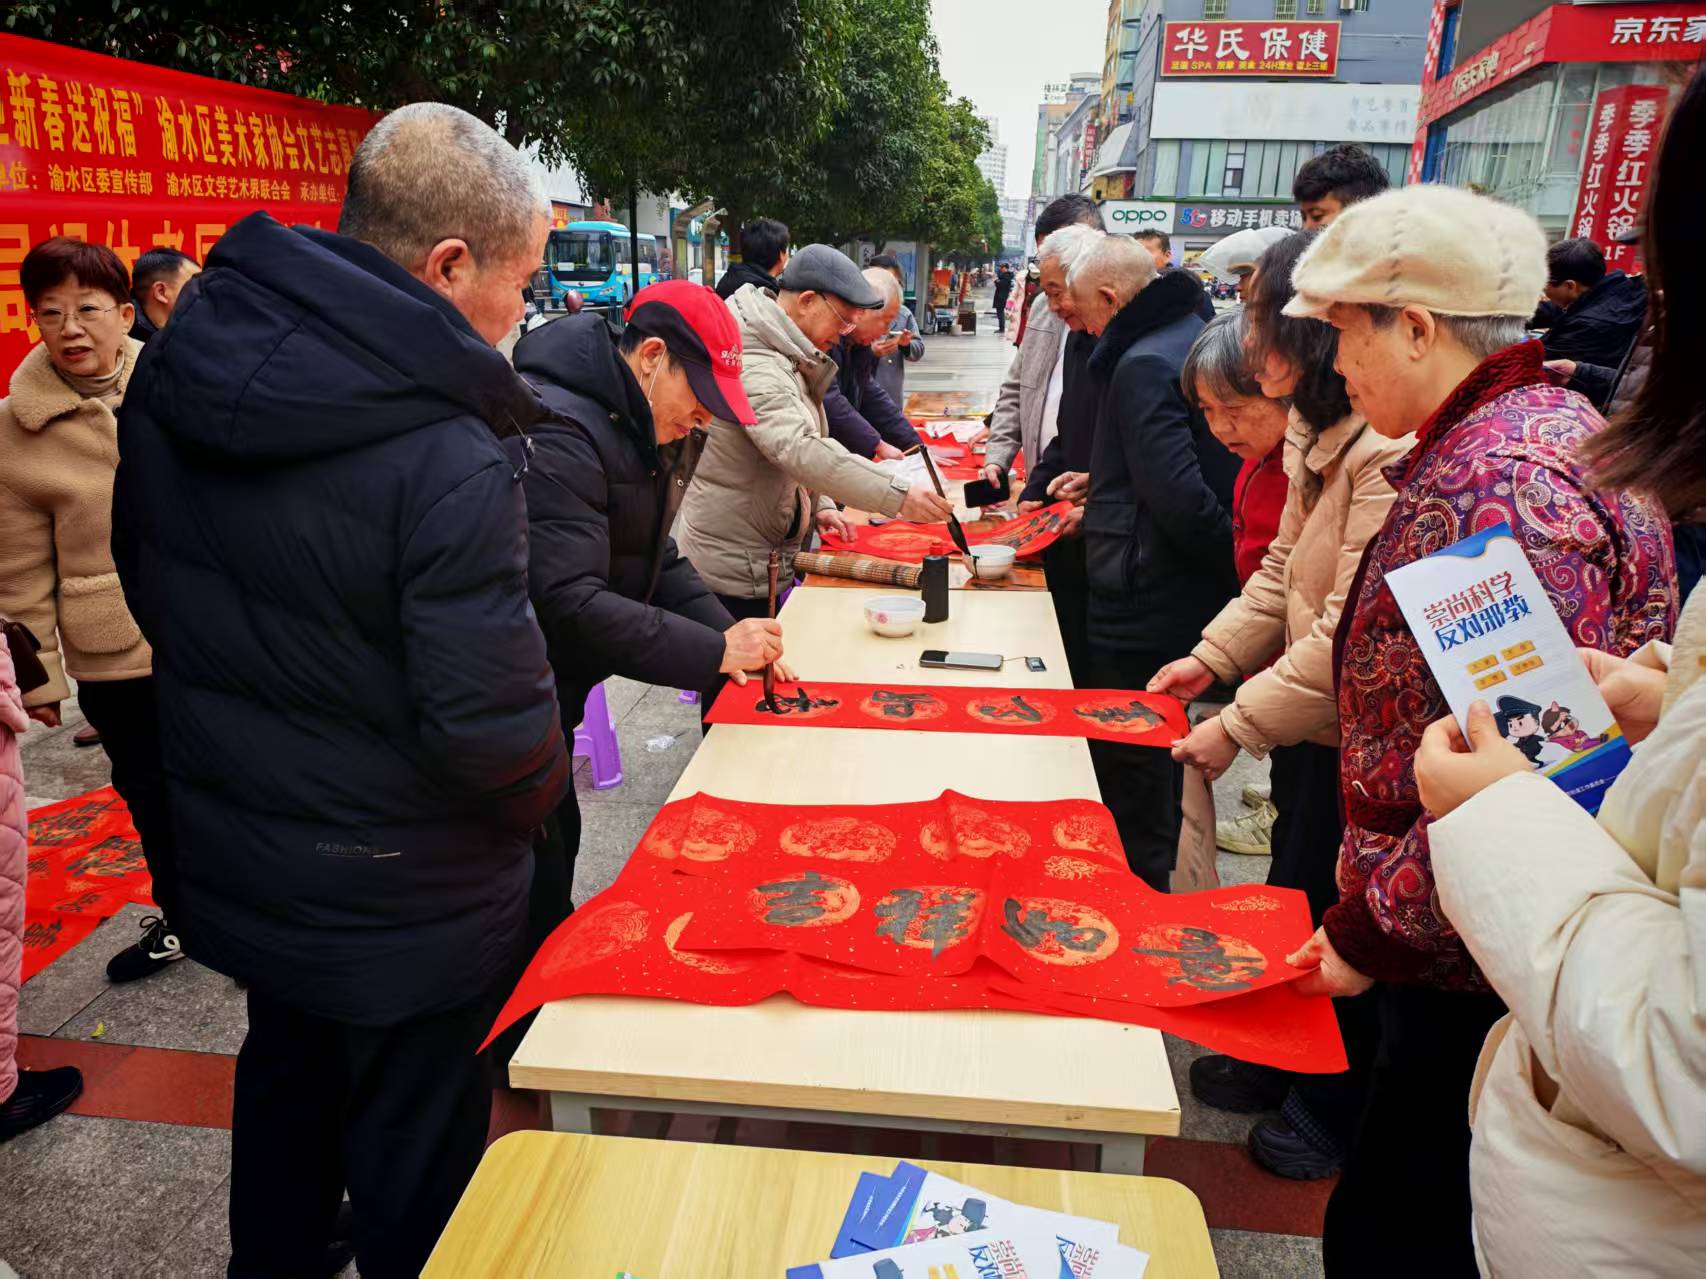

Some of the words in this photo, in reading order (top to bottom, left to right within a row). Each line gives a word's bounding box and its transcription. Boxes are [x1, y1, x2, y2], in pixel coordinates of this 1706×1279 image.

[1173, 27, 1329, 61] 华氏保健
[0, 68, 142, 157] 新春送祝福”
[48, 163, 153, 195] 渝水区委宣传部
[166, 172, 291, 201] 渝水区文学艺术界联合会
[1577, 103, 1616, 240] 季季红火锅
[1606, 100, 1657, 240] 季季红火锅
[1604, 246, 1627, 260] 1F
[1423, 571, 1517, 630] 崇尚科学
[1435, 594, 1533, 652] 反对邪教
